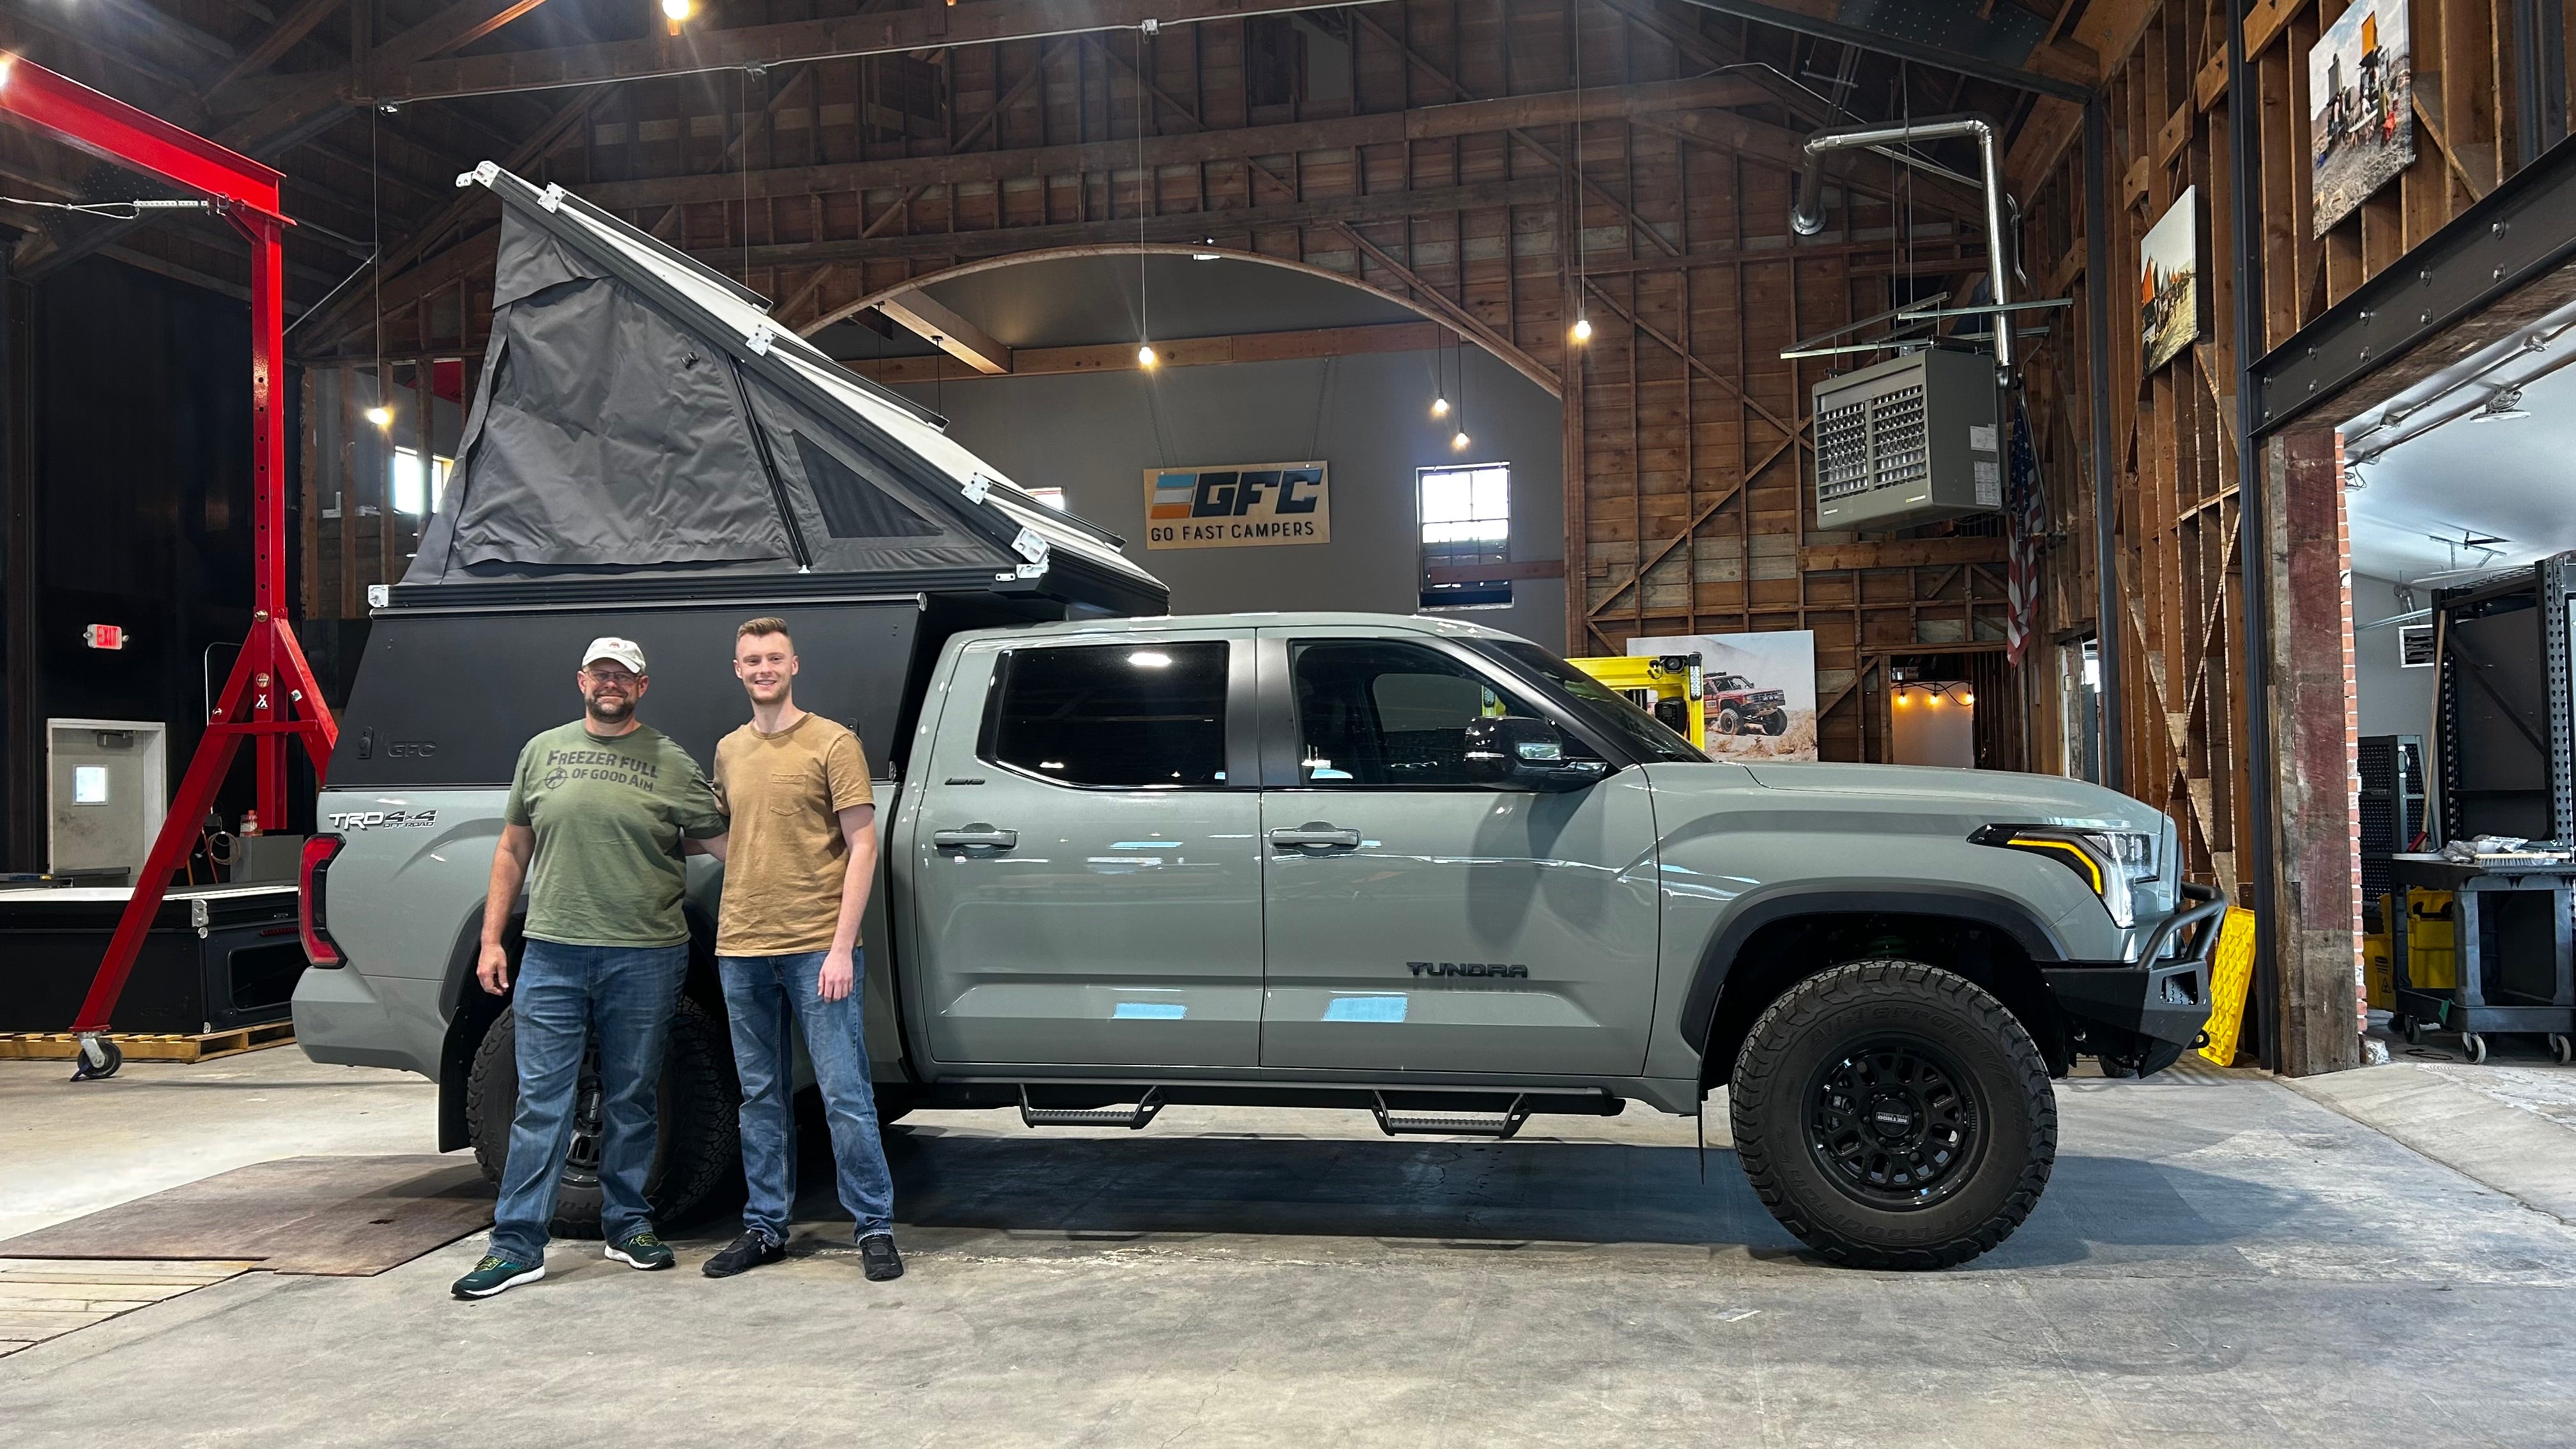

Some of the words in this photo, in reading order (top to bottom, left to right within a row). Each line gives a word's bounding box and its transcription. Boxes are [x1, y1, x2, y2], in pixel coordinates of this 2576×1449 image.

[1192, 468, 1323, 518] GFC
[1151, 527, 1174, 542] GO
[1183, 525, 1224, 540] FAST
[1231, 521, 1315, 539] CAMPERS
[96, 626, 118, 647] EXIT
[388, 741, 437, 758] GFC
[546, 749, 618, 767] FREEZER
[618, 755, 659, 779] FULL
[572, 768, 589, 779] OF
[590, 769, 627, 783] GOOD
[627, 774, 654, 792] AIM
[328, 811, 385, 831] TRD
[1406, 962, 1528, 978] TUNDRA
[1809, 1003, 1979, 1052] All-Terrain
